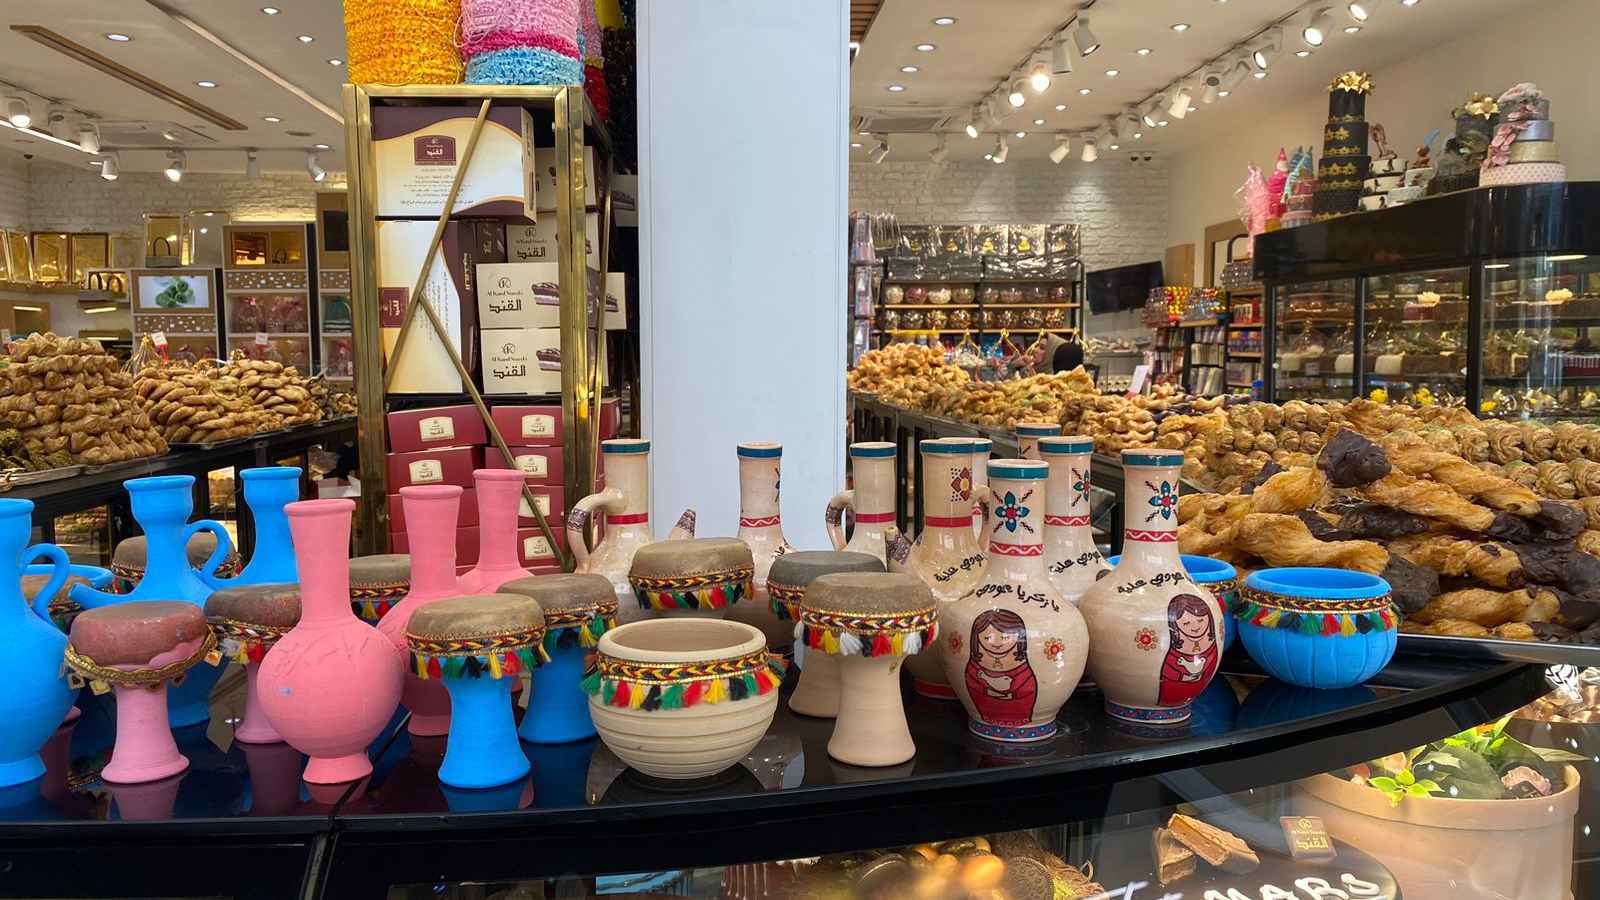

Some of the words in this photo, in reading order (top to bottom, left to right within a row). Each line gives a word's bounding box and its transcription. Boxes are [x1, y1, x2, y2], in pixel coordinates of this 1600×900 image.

[517, 247, 546, 259] القند
[489, 299, 521, 313] القند
[493, 365, 526, 379] القند
